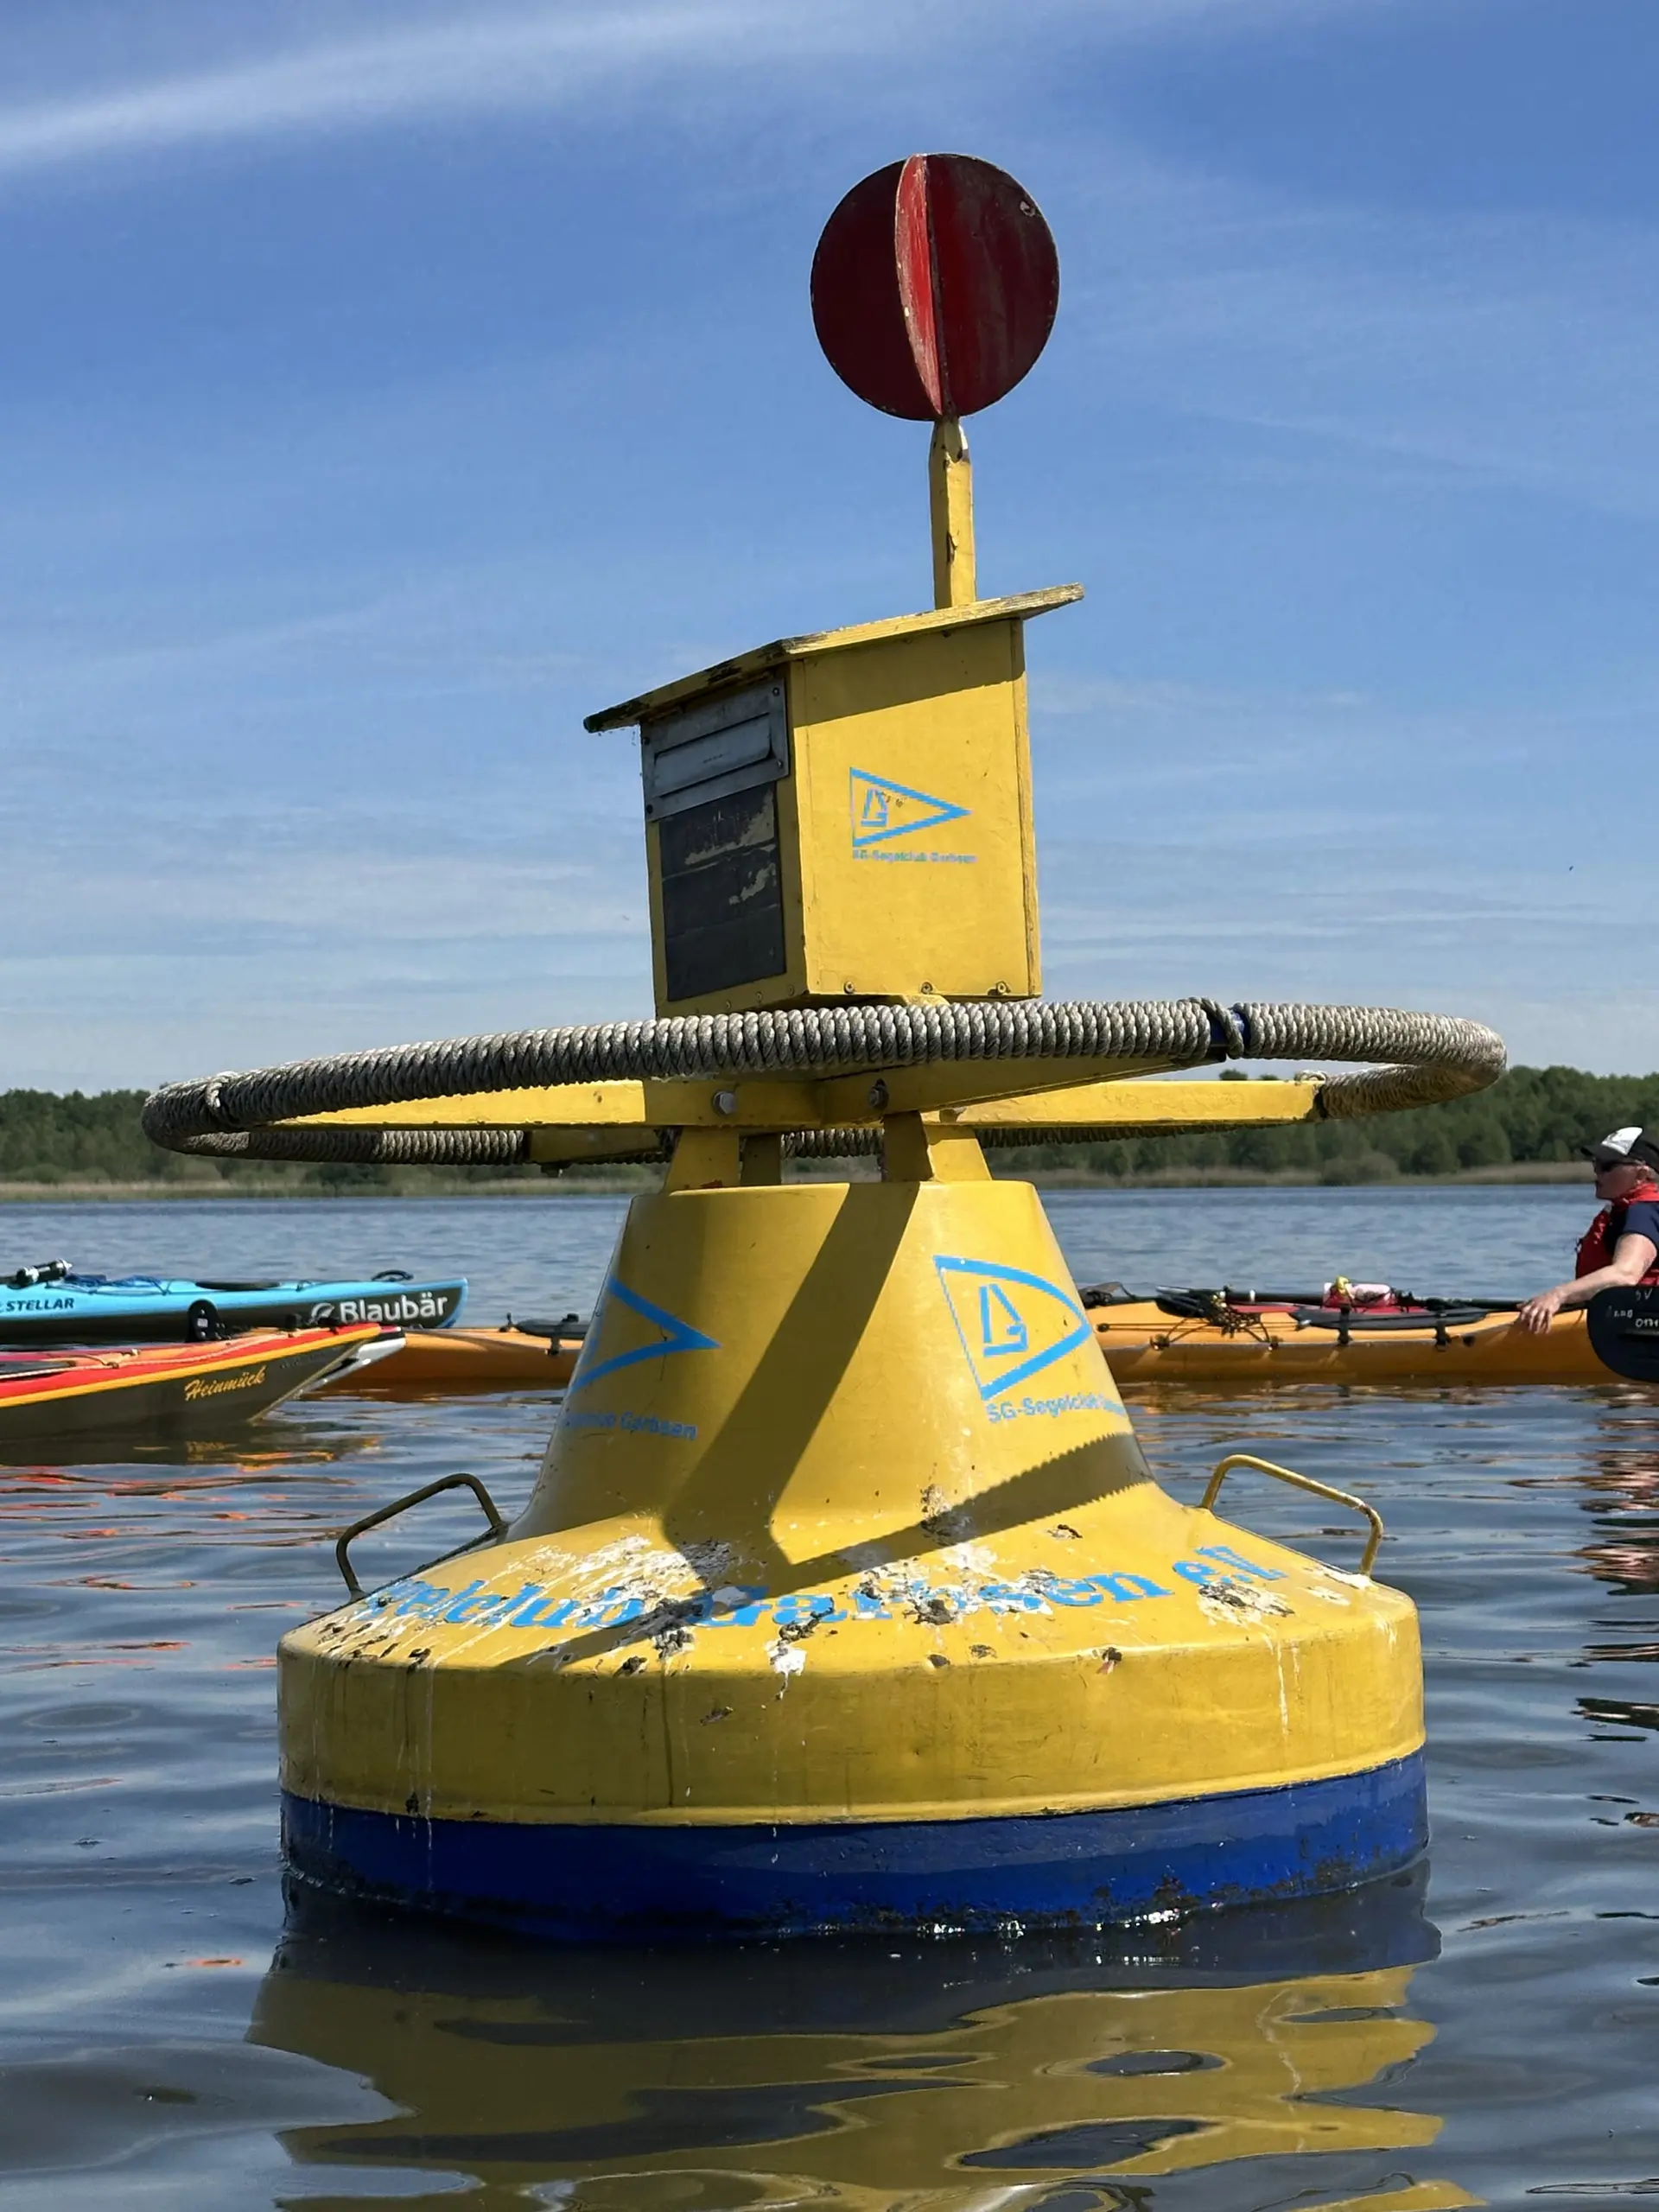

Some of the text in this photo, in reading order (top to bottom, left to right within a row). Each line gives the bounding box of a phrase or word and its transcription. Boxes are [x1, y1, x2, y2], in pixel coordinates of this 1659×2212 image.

[6, 1298, 74, 1312] STELLAR
[340, 1292, 448, 1324] Blaubär
[184, 1364, 267, 1402] Heinmück
